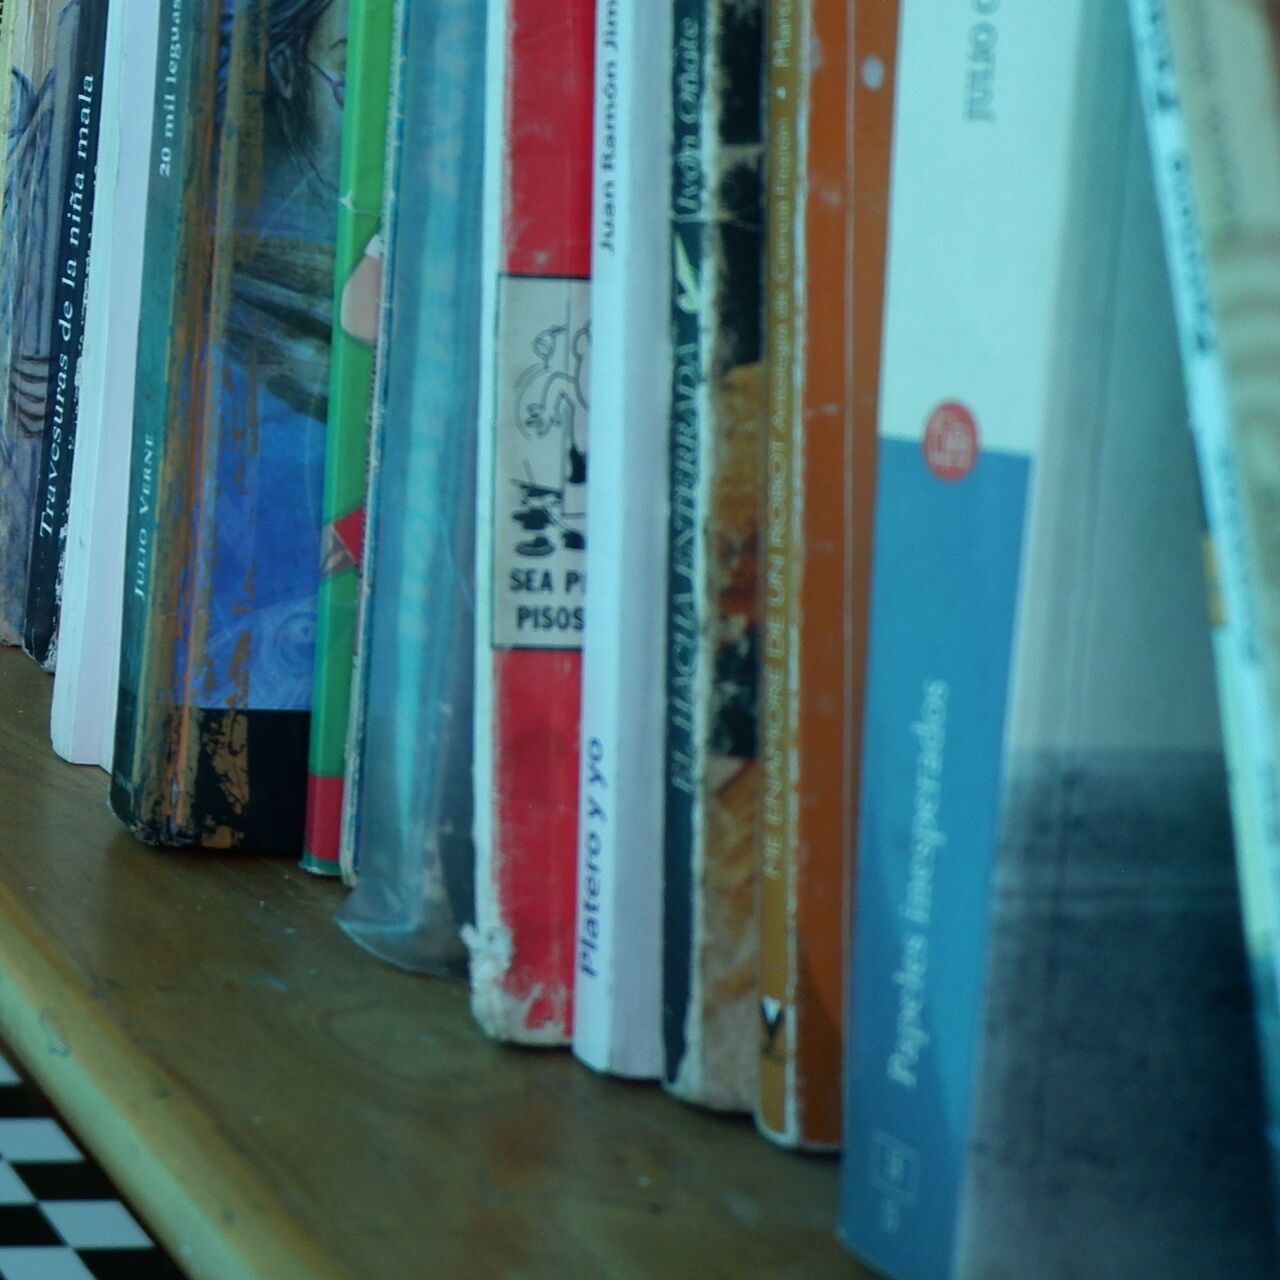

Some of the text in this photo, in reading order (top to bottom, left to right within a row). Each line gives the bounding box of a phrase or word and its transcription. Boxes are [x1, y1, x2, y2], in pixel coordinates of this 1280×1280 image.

[962, 22, 999, 123] JULIO
[77, 73, 94, 160] mala
[163, 94, 176, 138] mil
[601, 58, 618, 172] Ramón
[159, 146, 172, 178] 20
[66, 170, 85, 247] niña
[600, 179, 616, 254] Juan
[61, 256, 78, 289] la
[57, 297, 74, 341] de
[39, 353, 68, 538] Travesuras
[134, 433, 155, 601] JULIO VERNE
[768, 442, 789, 548] ROBOT
[509, 567, 553, 592] SEA
[517, 606, 585, 631] PISOS
[767, 554, 787, 608] UN
[899, 678, 950, 924] inesperados
[580, 737, 608, 977] Platero y yo
[886, 933, 930, 1091] Papeles
